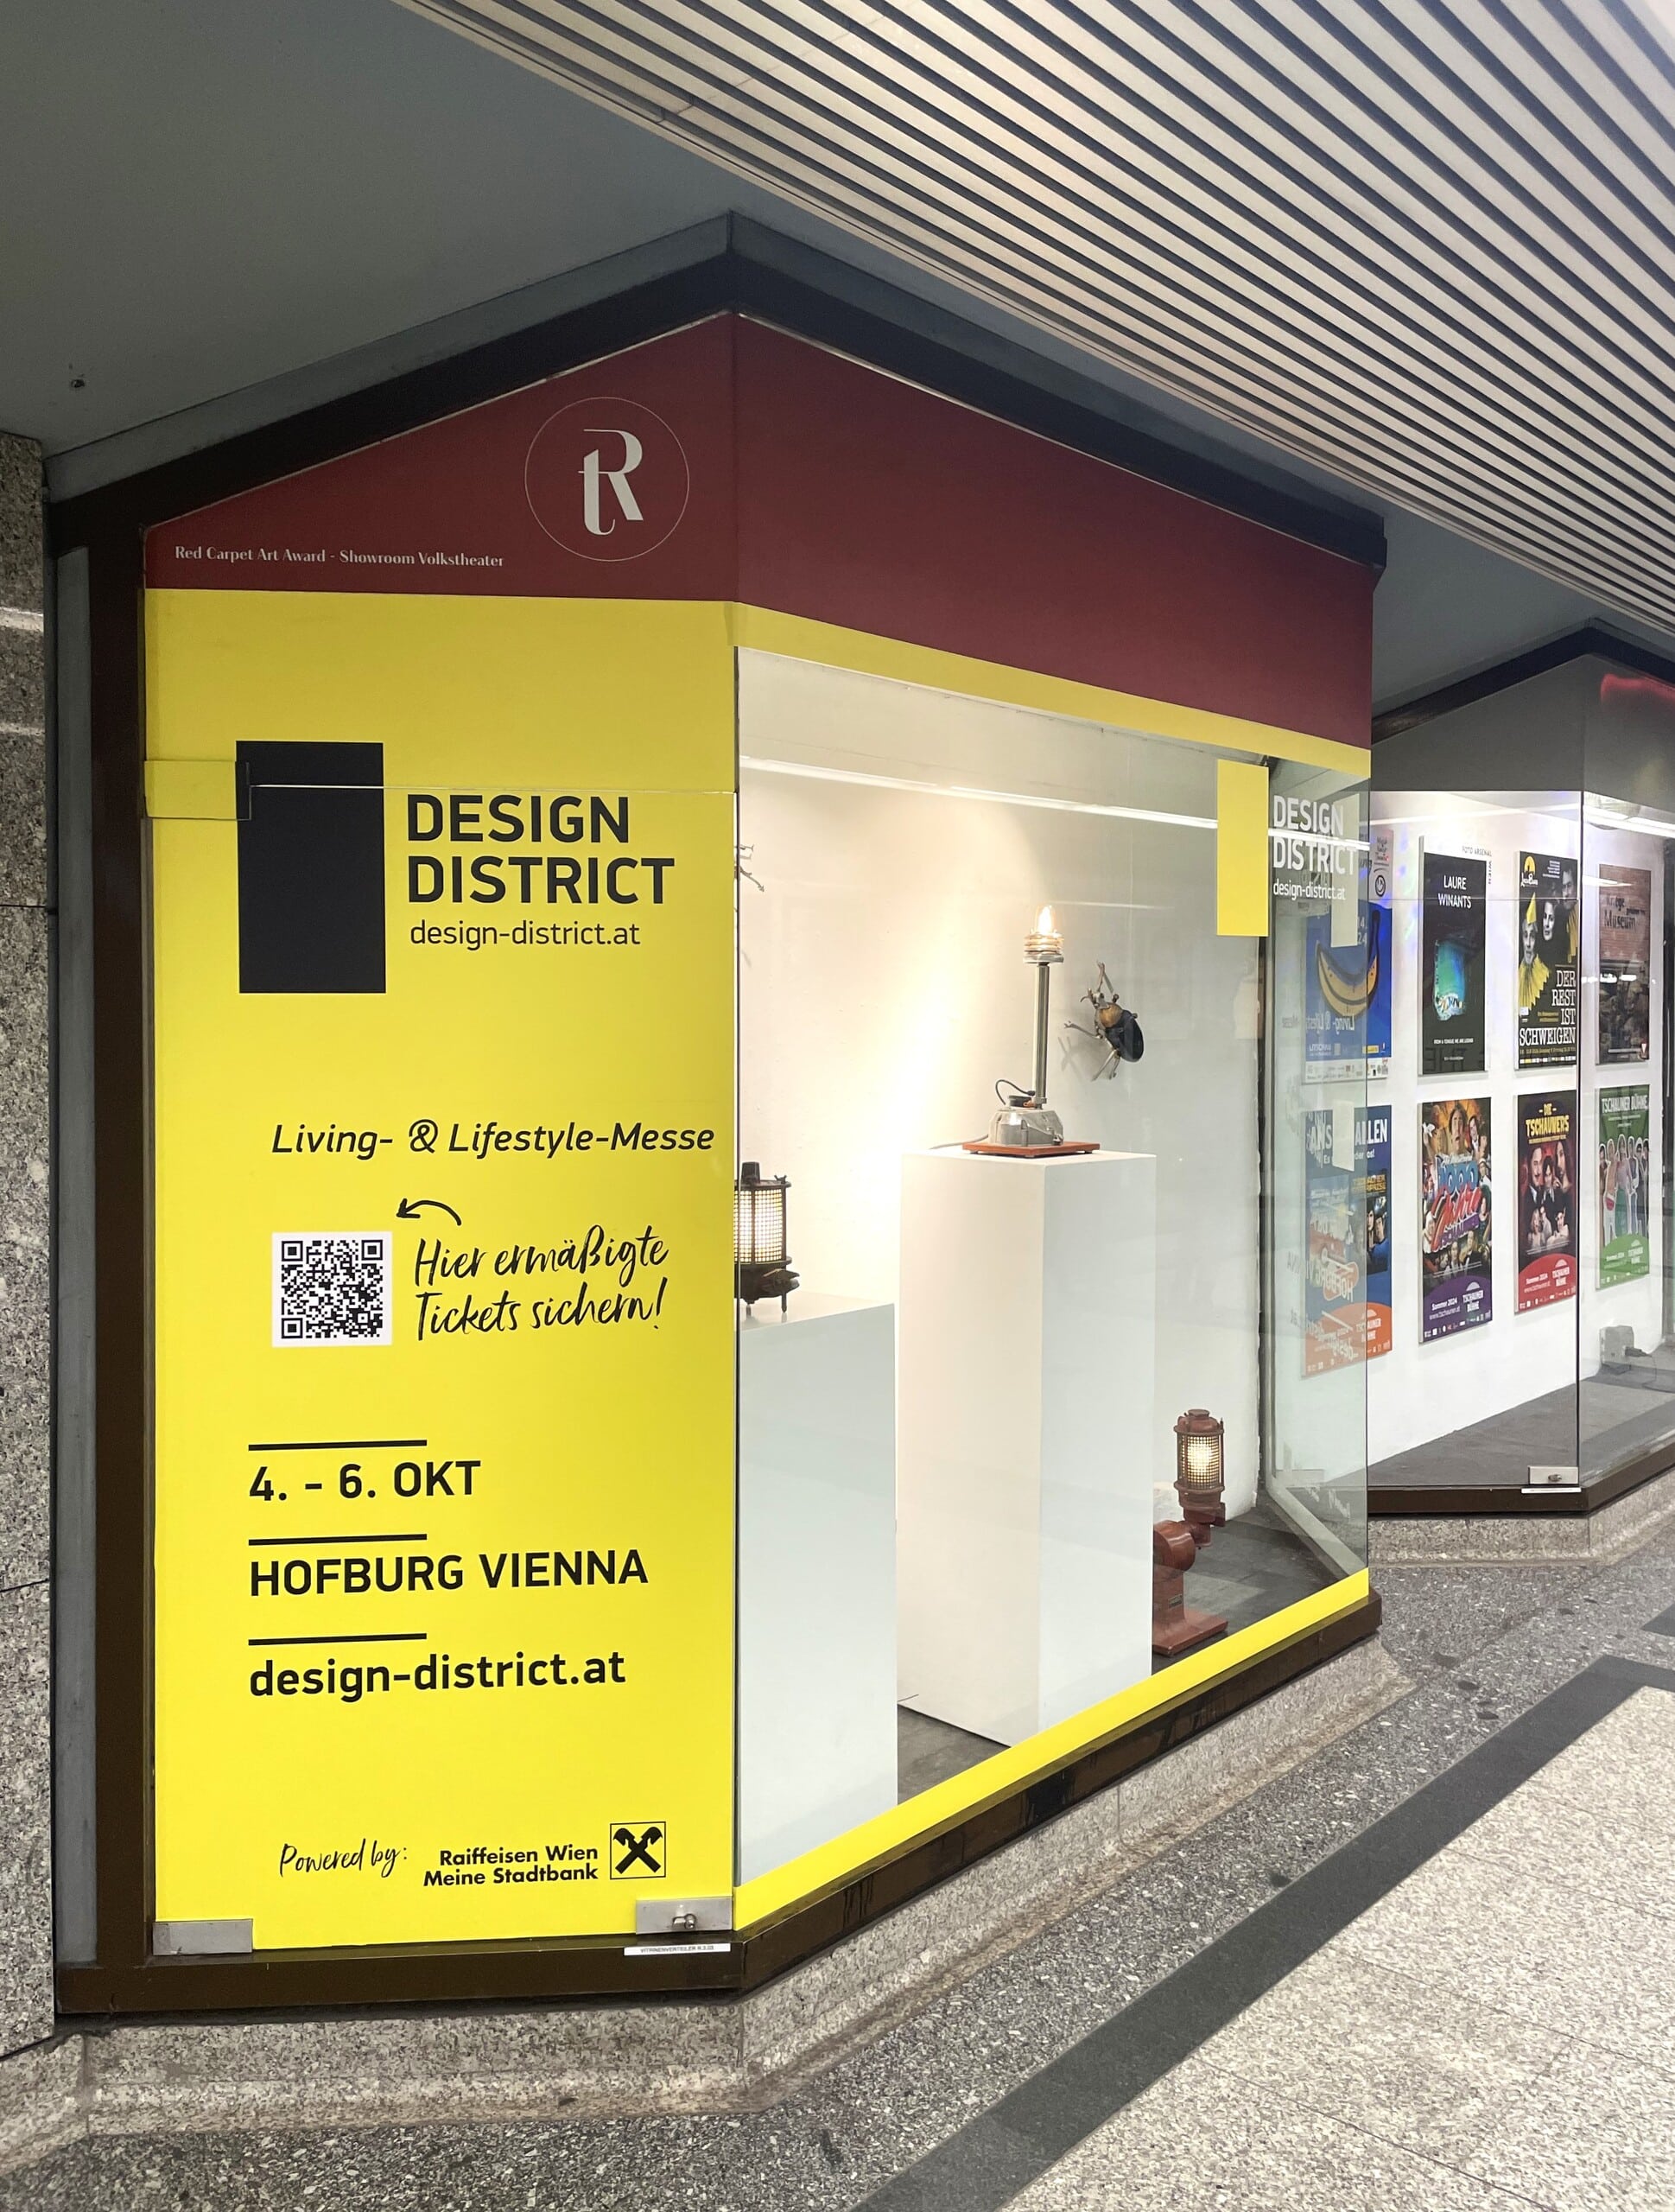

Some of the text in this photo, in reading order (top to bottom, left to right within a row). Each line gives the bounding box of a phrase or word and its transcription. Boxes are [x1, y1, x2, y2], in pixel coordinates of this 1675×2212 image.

[174, 546, 202, 560] Red
[206, 546, 253, 564] Carpet
[257, 548, 280, 562] Art
[282, 549, 327, 563] Award
[339, 550, 416, 565] Showroom
[417, 551, 504, 567] Volkstheater
[407, 794, 630, 843] DESIGN
[1273, 794, 1344, 836] DESIGN
[1273, 835, 1358, 875] DISTRICT
[408, 855, 675, 905] DISTRICT
[1272, 878, 1346, 900] design-district.at
[1443, 874, 1467, 890] LAURE
[1437, 893, 1472, 909] WINANTS
[409, 919, 641, 951] design-district.at
[1556, 969, 1577, 987] DER
[1551, 988, 1577, 1007] REST
[1560, 1007, 1577, 1026] IST
[1520, 1027, 1577, 1046] SCHWEIGEN
[272, 1119, 714, 1160] Living- & Lifestyle-Messe
[415, 1224, 670, 1288] Hier ermäßigte
[415, 1276, 669, 1342] Tickets sichern!
[249, 1466, 288, 1501] 4.
[339, 1463, 377, 1499] 6.
[394, 1460, 482, 1497] OKT
[250, 1548, 649, 1597] HOFBURG VIENNA
[249, 1651, 626, 1703] design-district.at
[279, 1838, 408, 1878] Powered by:
[440, 1844, 599, 1868] Raiffeisen Wien
[423, 1863, 599, 1888] Meine Stadtbank
